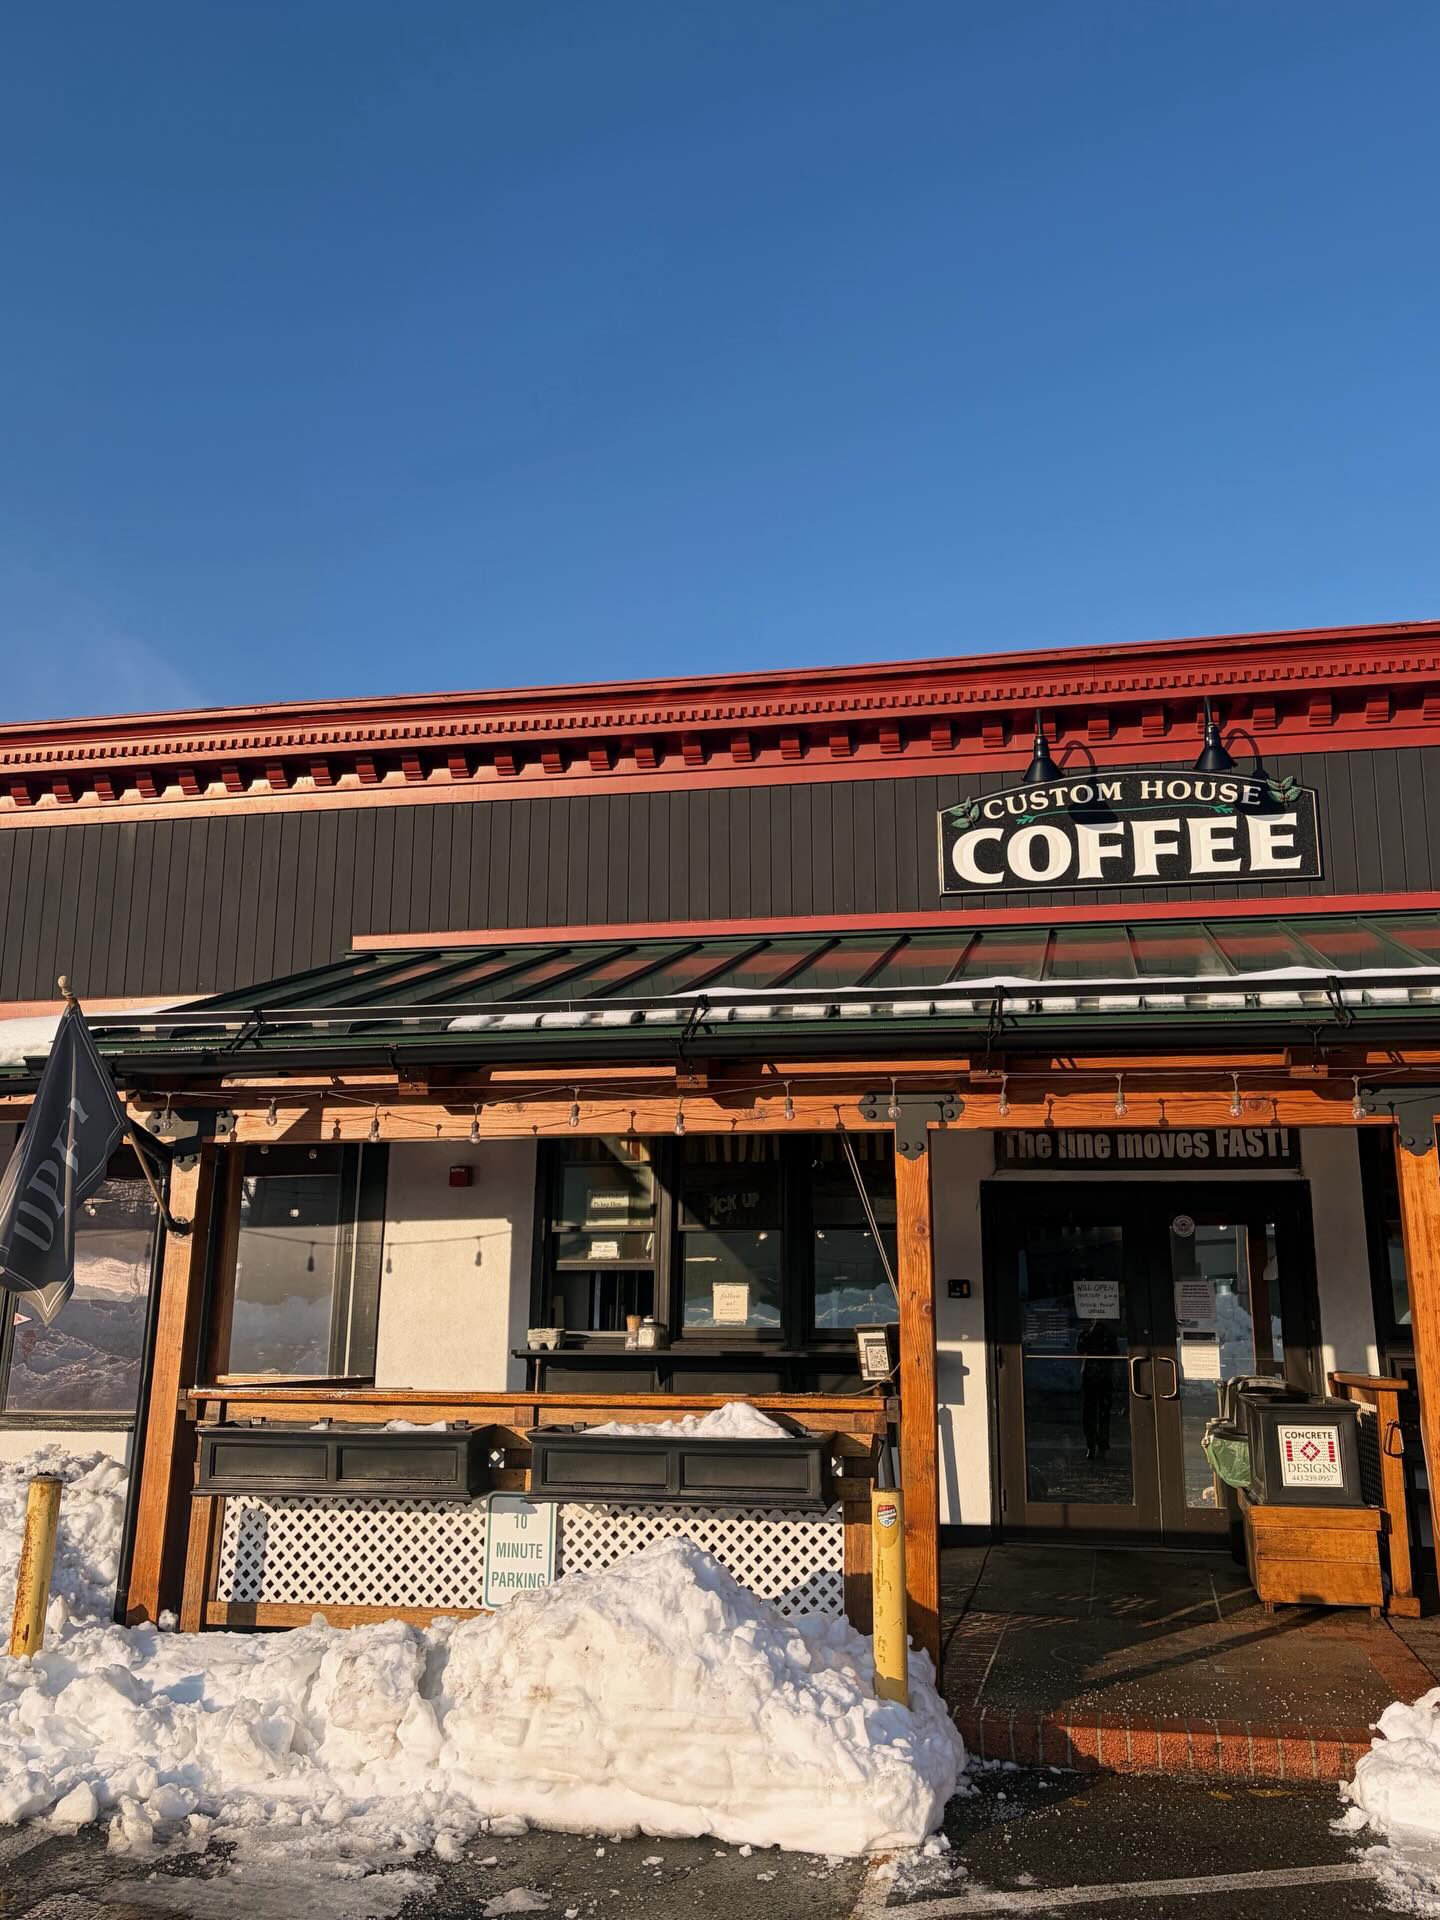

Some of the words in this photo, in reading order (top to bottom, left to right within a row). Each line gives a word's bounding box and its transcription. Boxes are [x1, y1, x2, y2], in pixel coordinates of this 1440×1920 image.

[983, 781, 1122, 820] CUSTOM
[1140, 780, 1262, 805] HOUSE
[951, 812, 1303, 884] COFFEE
[1005, 1130, 1052, 1160] The
[1058, 1129, 1111, 1159] line
[1117, 1131, 1210, 1159] moves
[1215, 1128, 1290, 1158] FAST!
[1284, 1431, 1333, 1439] CONCRETE
[1287, 1463, 1338, 1473] DESIGNS
[513, 1514, 528, 1529] 10
[495, 1542, 543, 1559] MINUTE
[491, 1571, 545, 1588] PARKING
